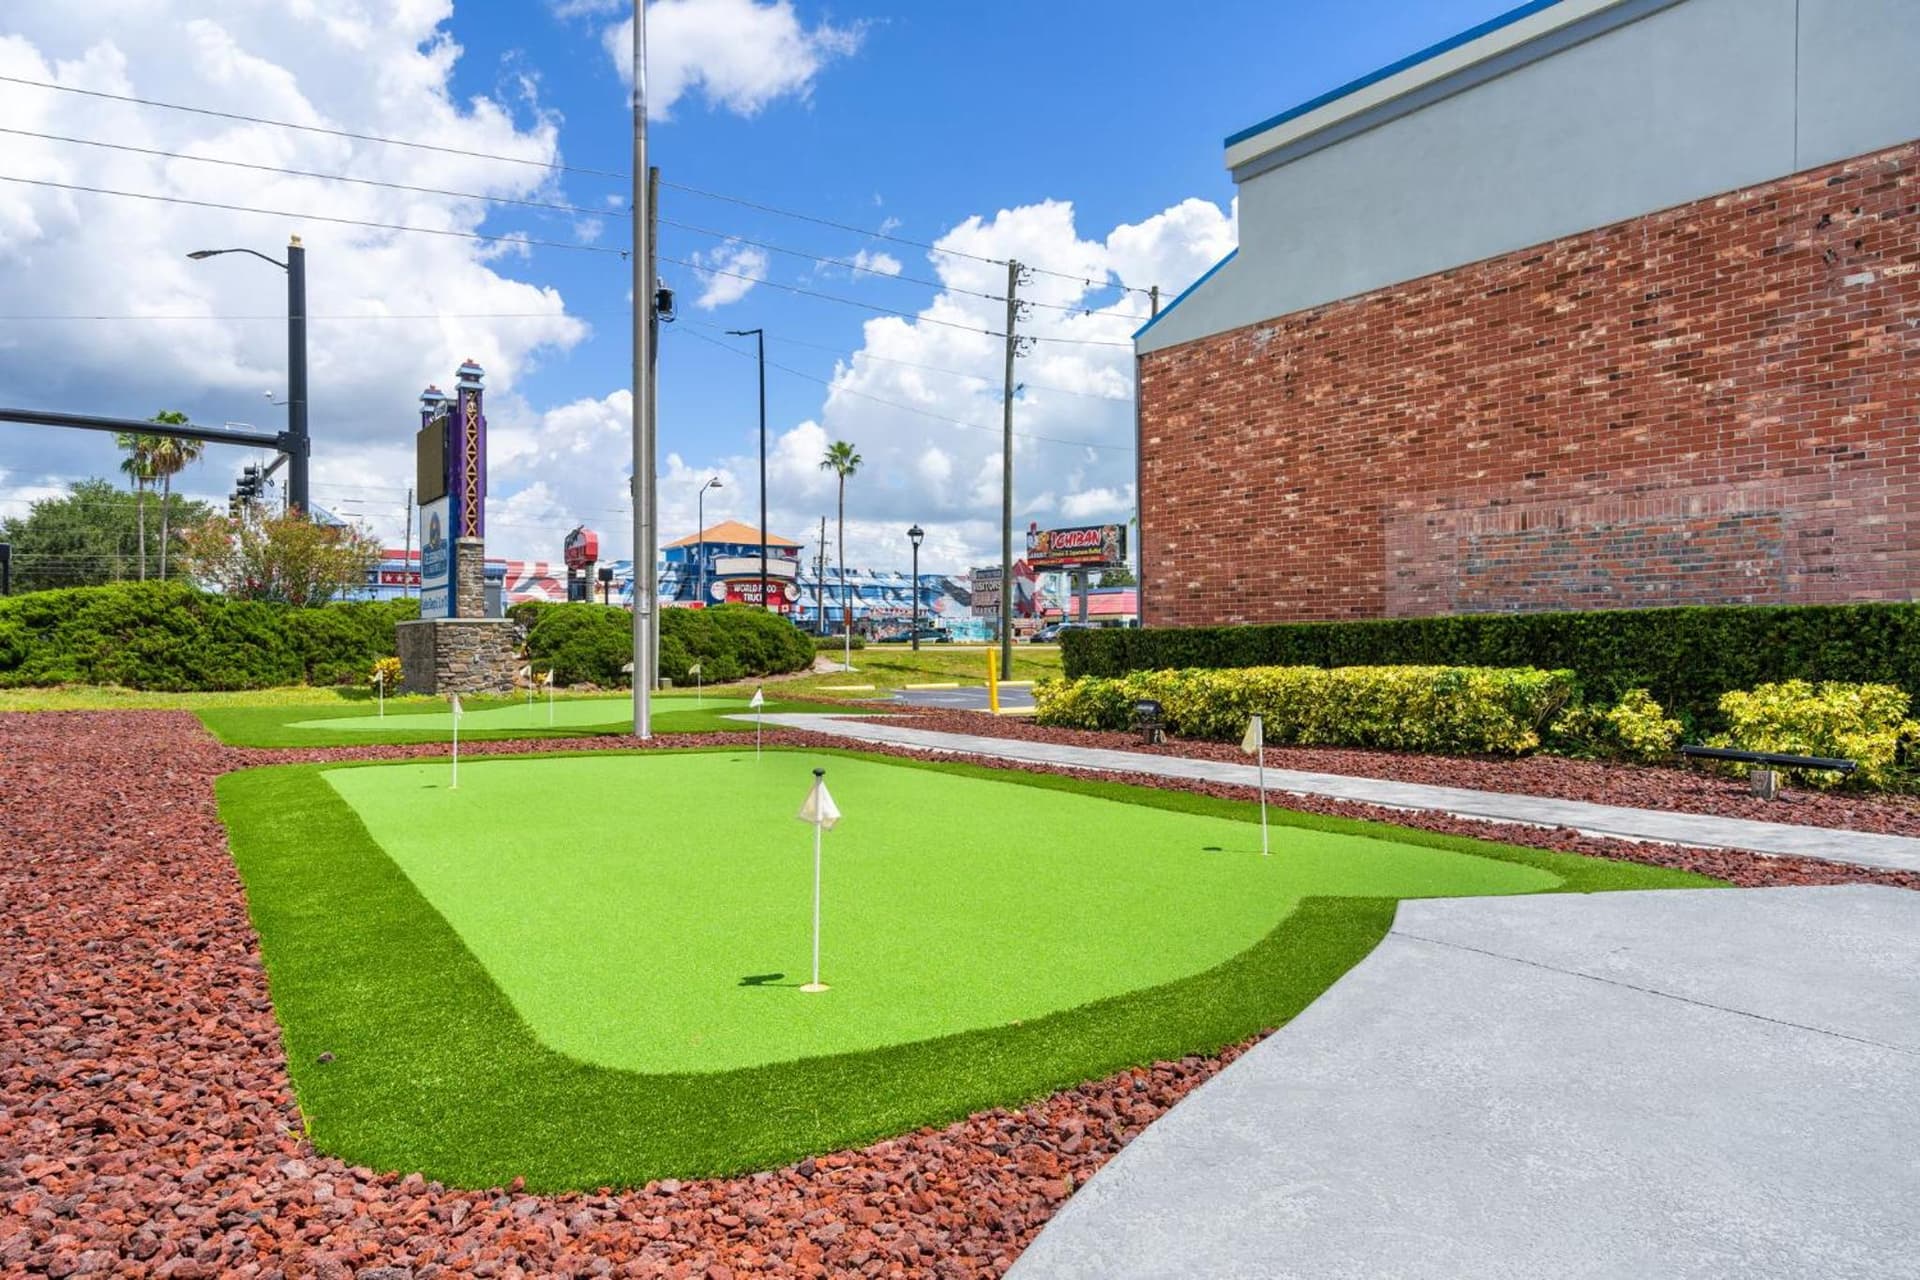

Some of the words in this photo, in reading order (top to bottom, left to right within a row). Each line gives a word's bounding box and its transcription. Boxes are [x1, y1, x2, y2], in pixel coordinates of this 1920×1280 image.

[1051, 529, 1102, 549] ICHIBAN
[734, 584, 757, 593] WORLD
[758, 584, 776, 593] FOD
